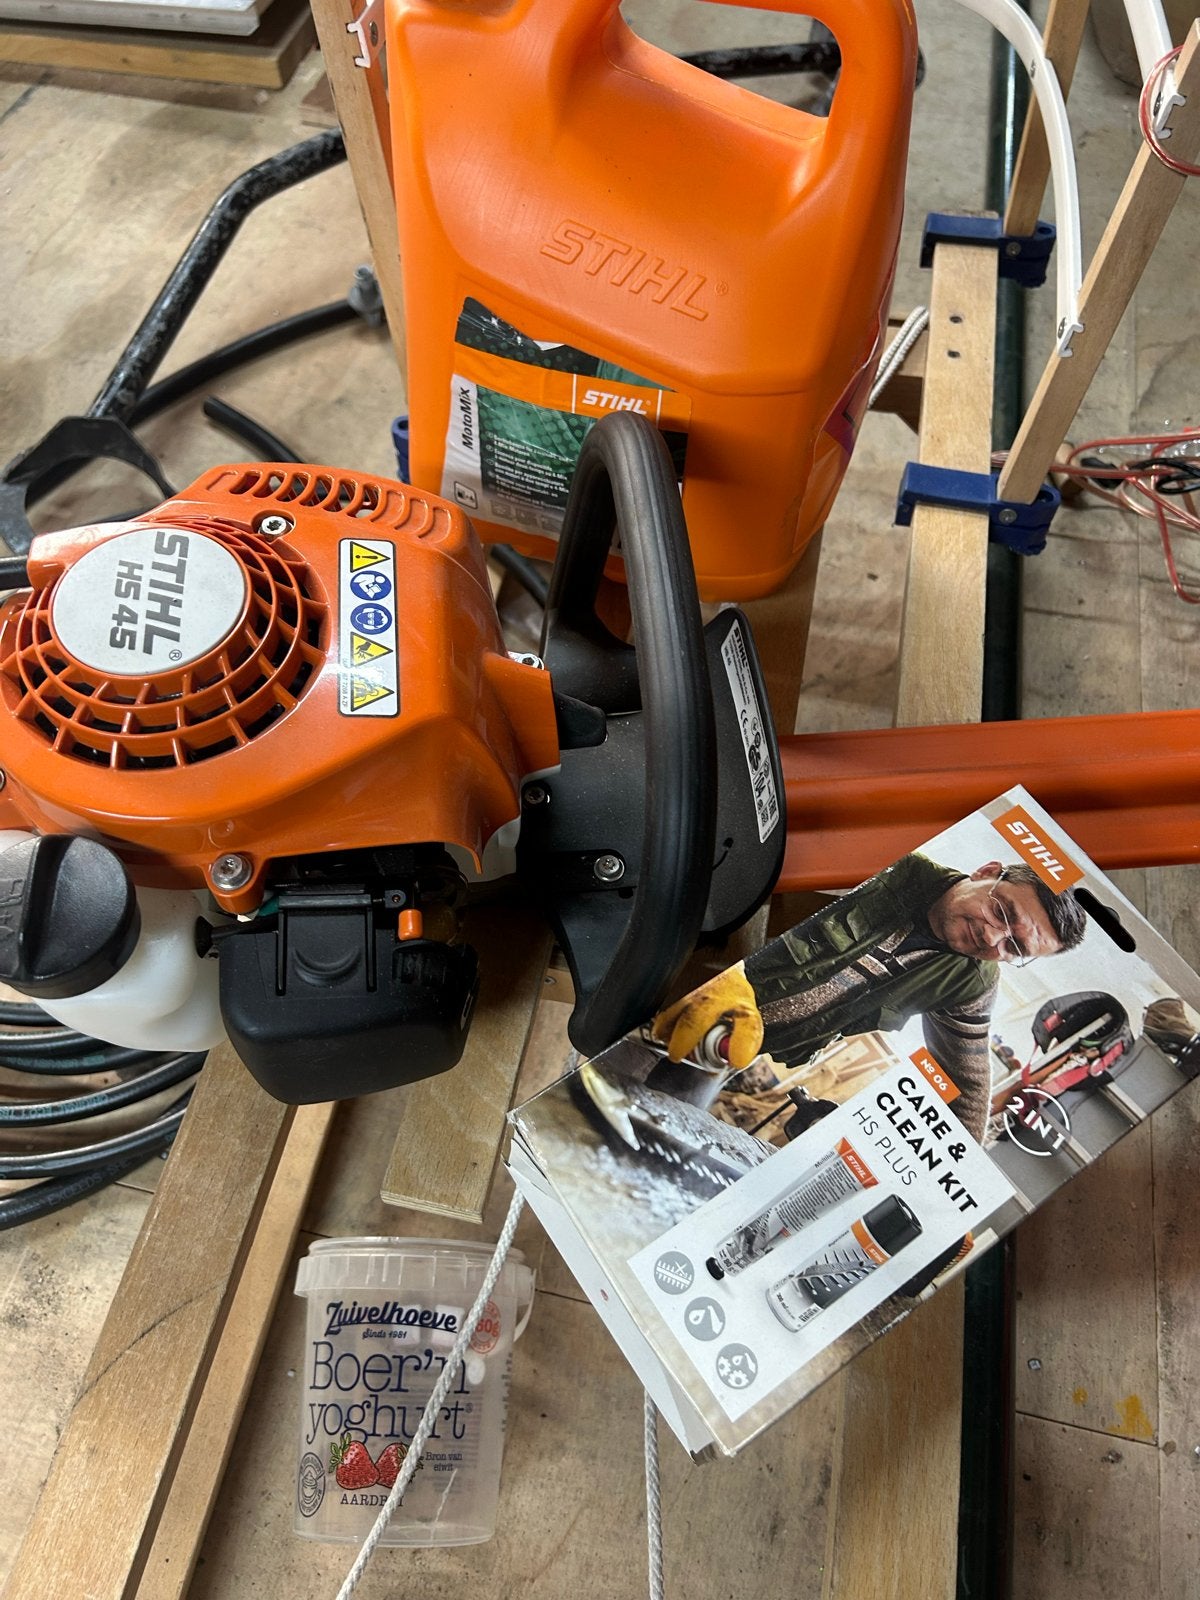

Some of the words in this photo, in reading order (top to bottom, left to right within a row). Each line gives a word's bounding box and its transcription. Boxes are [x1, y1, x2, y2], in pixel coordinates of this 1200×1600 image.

[540, 218, 709, 322] STIHL
[460, 387, 473, 450] MotoMix
[582, 389, 648, 416] STIHL
[114, 559, 144, 600] HS
[142, 531, 190, 655] STIHL
[109, 603, 139, 651] 45
[733, 627, 748, 669] STIHL
[1005, 820, 1066, 882] STIHL
[933, 1074, 949, 1091] 06
[897, 1077, 952, 1140] CARE
[947, 1142, 967, 1163] &
[1006, 1096, 1025, 1115] 2
[1024, 1109, 1053, 1139] IN
[1052, 1132, 1066, 1150] 1
[846, 1155, 868, 1179] STIHL
[852, 1107, 879, 1136] HS
[875, 1136, 917, 1185] PLUS
[876, 1092, 943, 1171] CLEAN
[937, 1171, 978, 1212] KIT
[324, 1301, 458, 1336] Zuivelhoeve
[362, 1328, 386, 1339] Sinds
[388, 1331, 408, 1339] 1981
[306, 1394, 466, 1445] yoghurt
[425, 1452, 447, 1461] Bron
[448, 1453, 463, 1461] van
[340, 1493, 404, 1507] AARDBI
